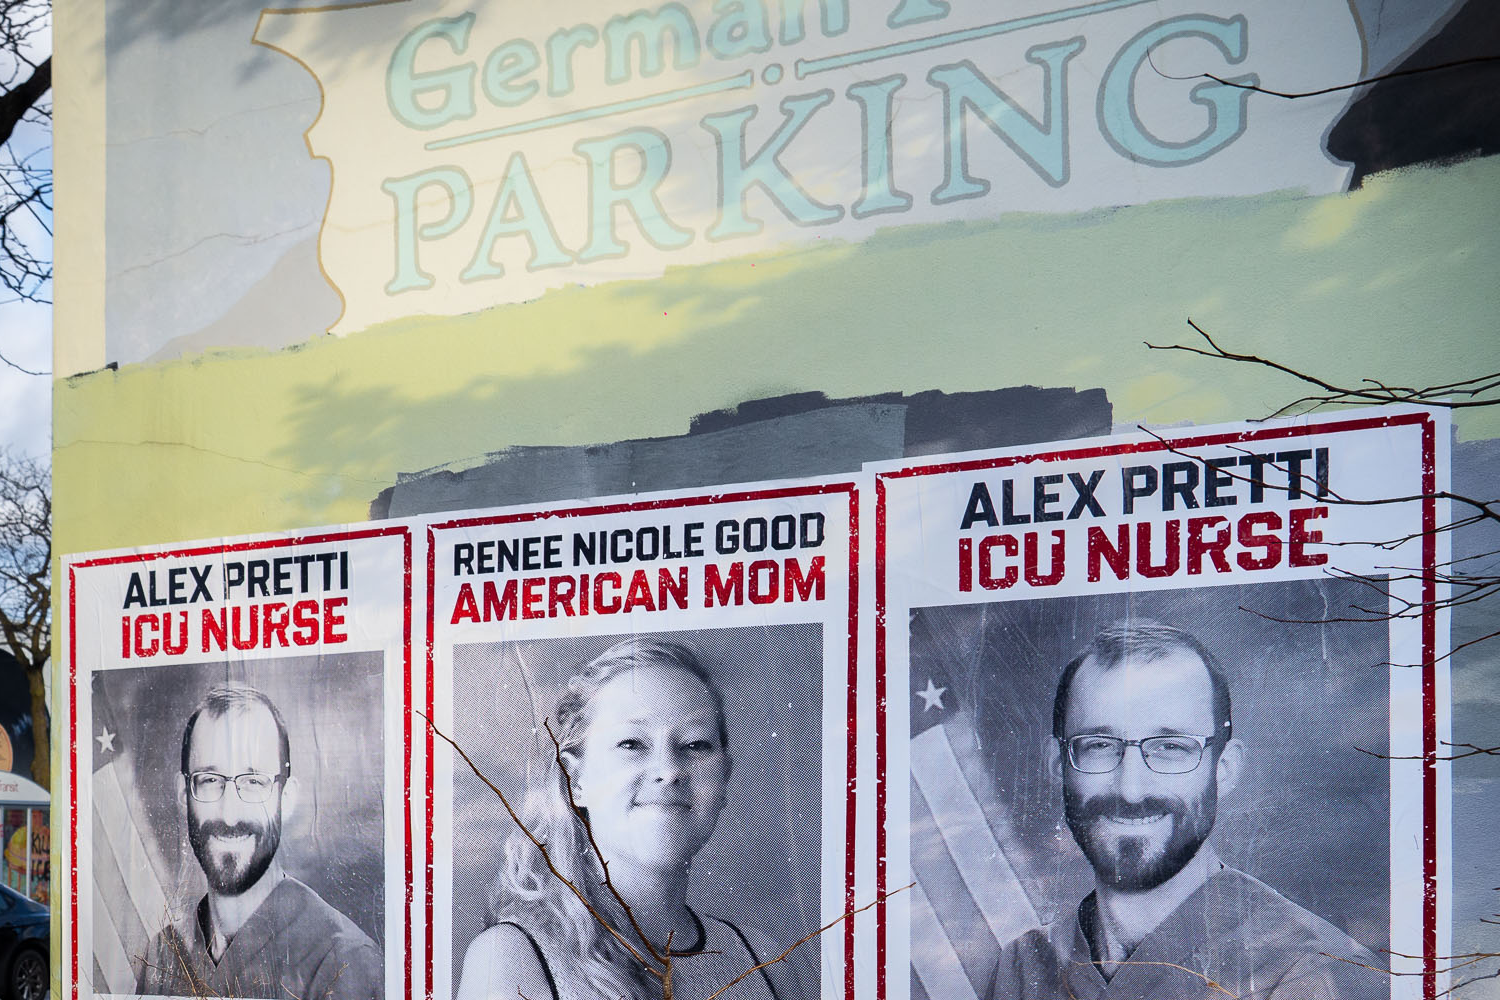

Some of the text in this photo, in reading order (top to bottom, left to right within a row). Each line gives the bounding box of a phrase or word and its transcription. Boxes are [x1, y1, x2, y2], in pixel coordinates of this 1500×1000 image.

[383, 13, 1256, 295] PARKING
[960, 448, 1330, 530] ALEX PRETTI
[453, 512, 826, 577] RENEE NICOLE GOOD
[958, 506, 1330, 593] ICU NURSE
[123, 551, 348, 610] ALEX PRETTI
[450, 556, 826, 625] AMERICAN MOM
[122, 597, 348, 660] ICU NURSE
